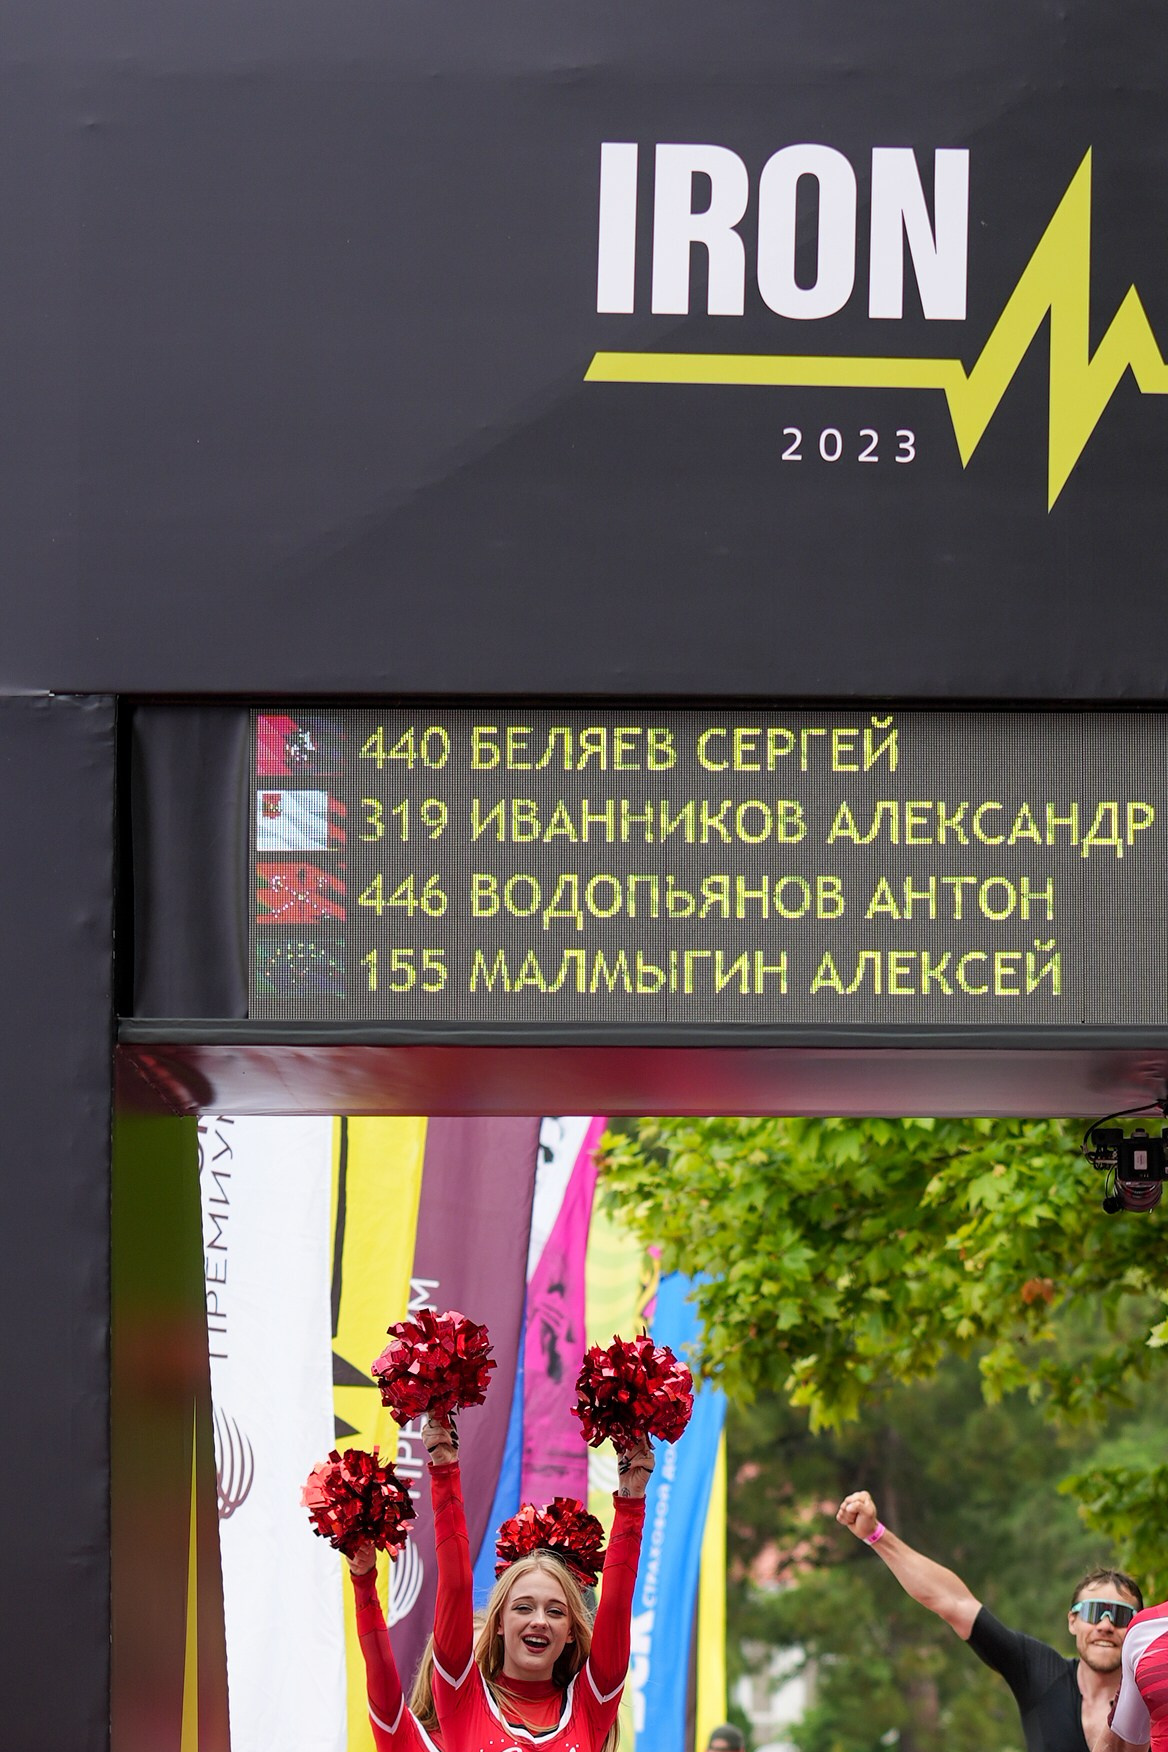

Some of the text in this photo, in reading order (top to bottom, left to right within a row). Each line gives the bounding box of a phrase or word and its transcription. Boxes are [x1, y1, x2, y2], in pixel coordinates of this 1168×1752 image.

[596, 142, 969, 321] IRON
[781, 427, 916, 463] 2023
[359, 727, 450, 769] 440
[471, 726, 677, 771] БЕЛЯЕВ
[698, 717, 899, 772] СЕРГЕЙ
[359, 798, 449, 842] 319
[471, 799, 808, 844] ИВАННИКОВ
[829, 801, 1156, 858] АЛЕКСАНДР
[358, 873, 449, 918] 446
[471, 874, 846, 930] ВОДОПЬЯНОВ
[866, 875, 1055, 921] АНТОН
[364, 948, 449, 993] 155
[471, 948, 788, 995] МАЛМЫГИН
[811, 939, 1062, 996] АЛЕКСЕЙ
